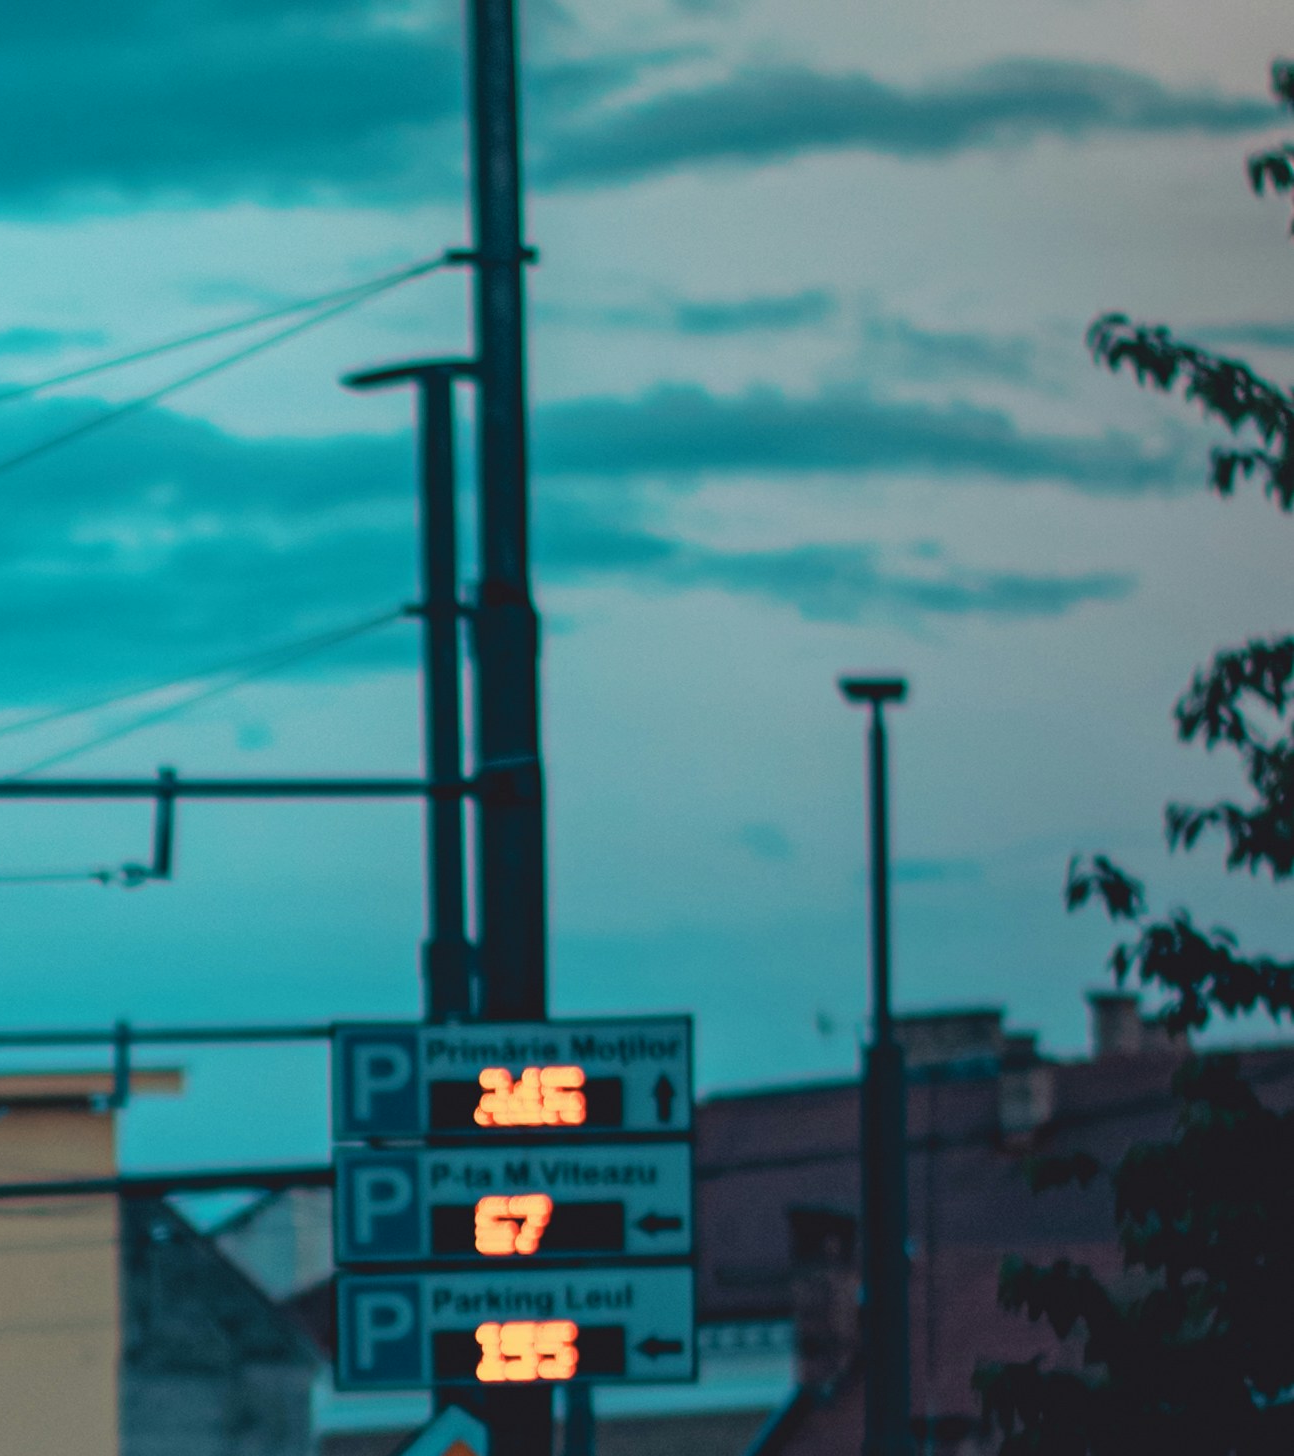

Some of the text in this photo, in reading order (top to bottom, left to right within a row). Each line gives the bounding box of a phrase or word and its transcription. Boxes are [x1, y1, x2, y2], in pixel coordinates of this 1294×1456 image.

[352, 1042, 412, 1122] P
[353, 1166, 414, 1244] P
[474, 1193, 554, 1256] 67
[356, 1291, 416, 1371] P
[431, 1283, 634, 1320] Parking Leul
